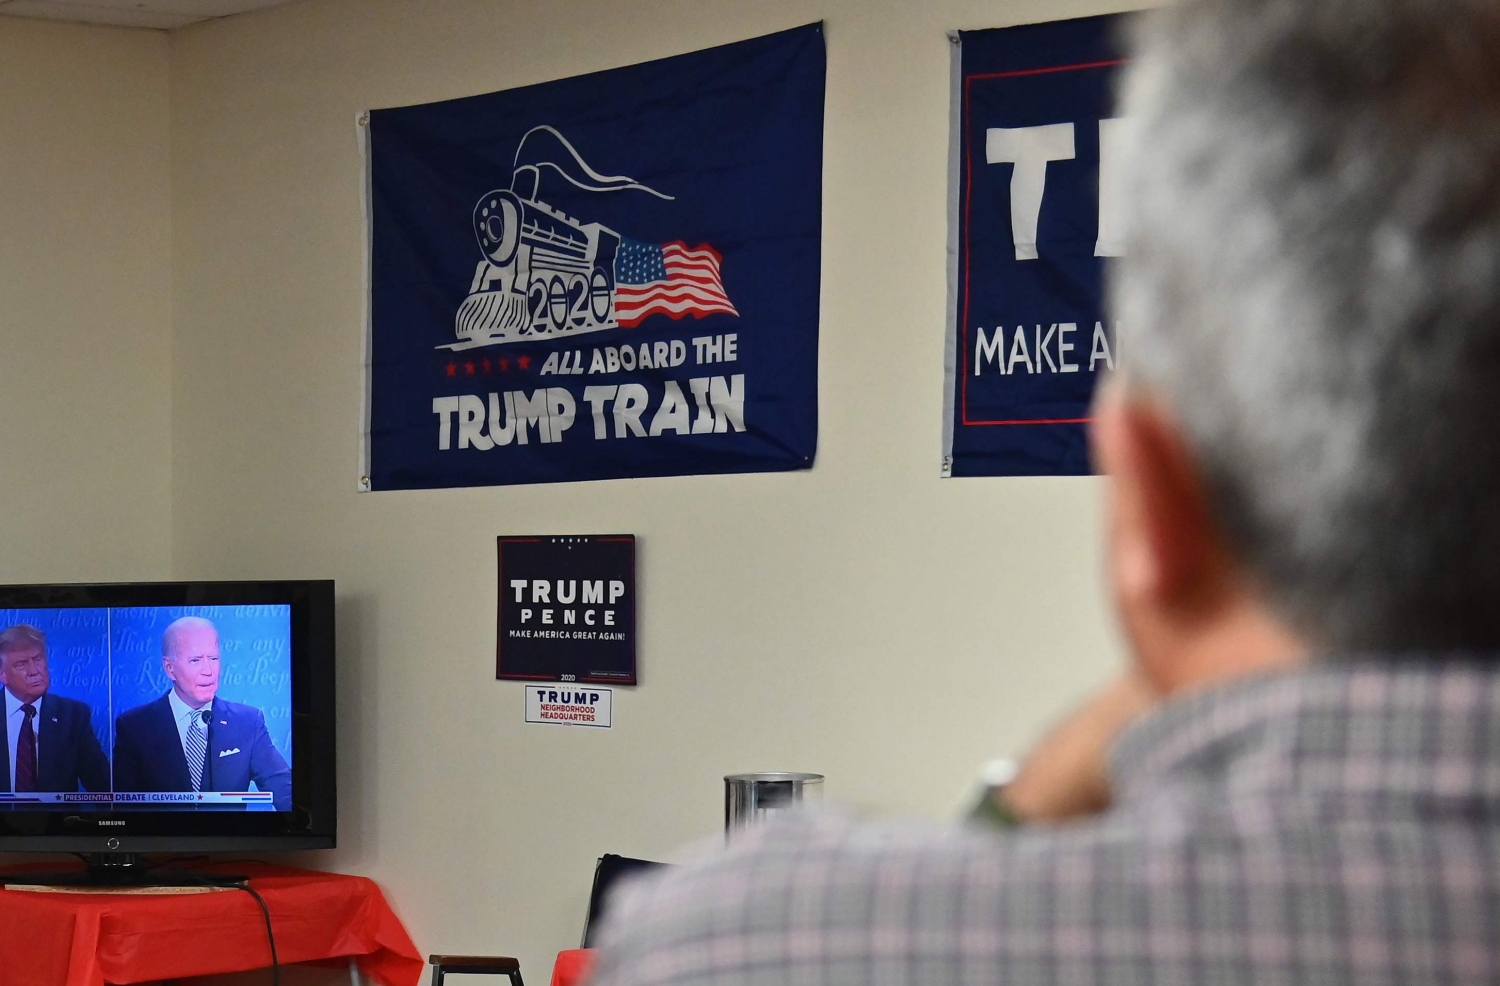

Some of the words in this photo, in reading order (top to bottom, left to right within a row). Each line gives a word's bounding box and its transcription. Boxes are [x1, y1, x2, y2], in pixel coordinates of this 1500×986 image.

[529, 266, 611, 332] 2020
[540, 350, 584, 376] ALL
[590, 340, 686, 374] ABOARD
[692, 333, 738, 364] THE
[974, 322, 1079, 376] MAKE
[432, 387, 576, 451] TRUMP
[583, 374, 747, 440] TRAIN
[510, 579, 625, 605] TRUMP
[520, 608, 615, 626] PENCE
[509, 630, 531, 638] MAKE
[533, 630, 571, 639] AMERICA
[572, 631, 597, 640] GREAT
[598, 632, 626, 641] AGAIN!
[561, 674, 576, 682] 2020
[537, 690, 600, 705] TRUMP
[540, 703, 596, 714] NEIGHBORHOOD
[540, 711, 596, 722] HEADQUARTERS
[115, 793, 146, 801] DEBATE
[152, 793, 195, 801] CLEVELAND
